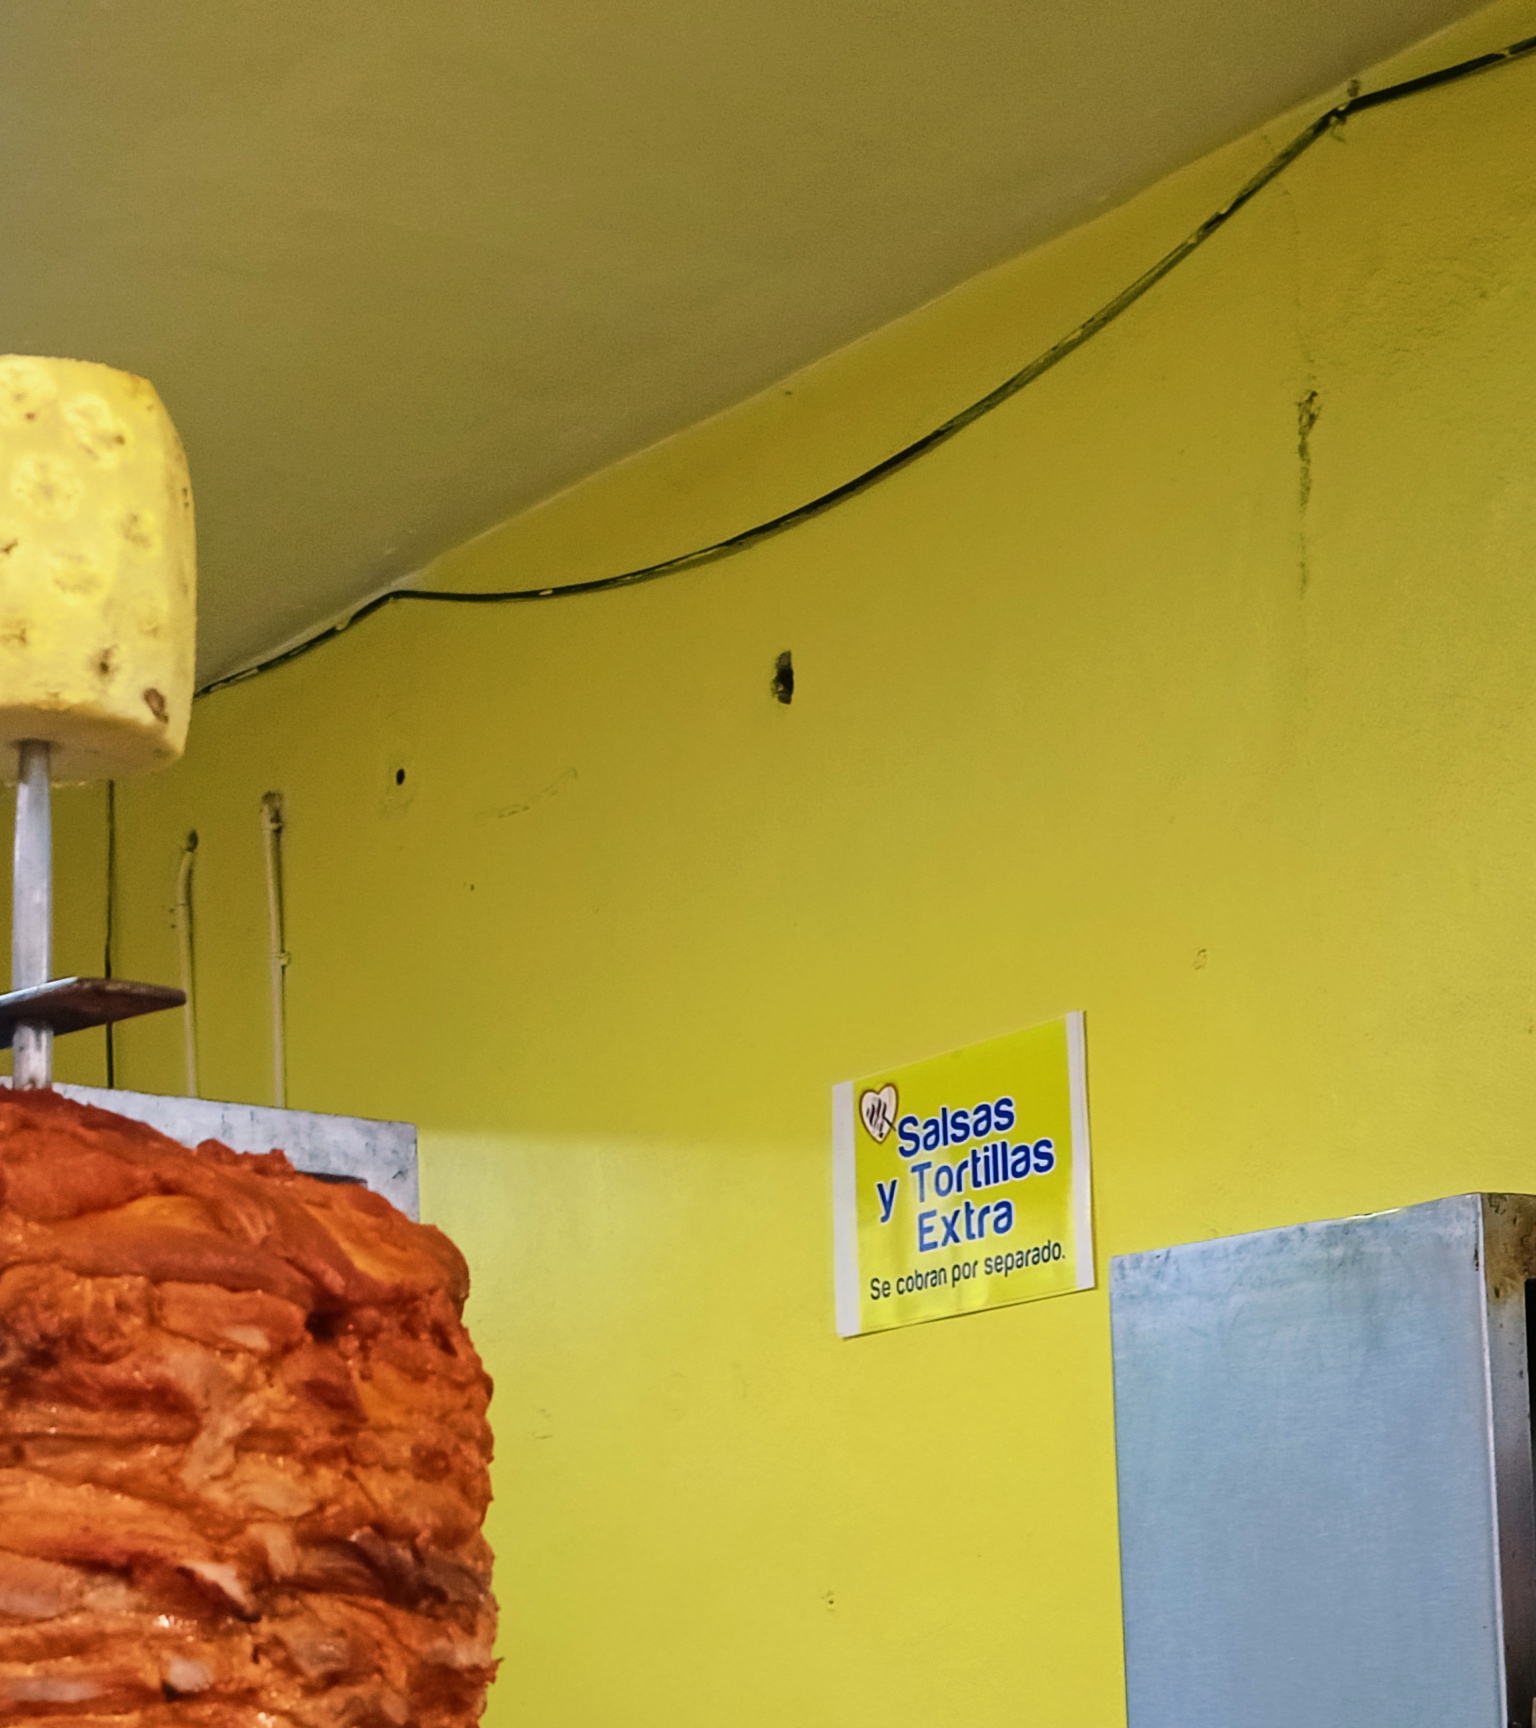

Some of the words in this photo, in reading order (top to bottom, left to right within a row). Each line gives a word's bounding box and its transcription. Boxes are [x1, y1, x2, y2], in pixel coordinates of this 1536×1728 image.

[897, 1097, 1014, 1157] Salsas
[876, 1179, 897, 1222] y
[911, 1138, 1055, 1202] Tortillas
[918, 1200, 1013, 1252] Extra
[870, 1278, 890, 1300] Se
[896, 1264, 947, 1295] cobran
[951, 1260, 978, 1287] por
[984, 1240, 1065, 1277] separado.
